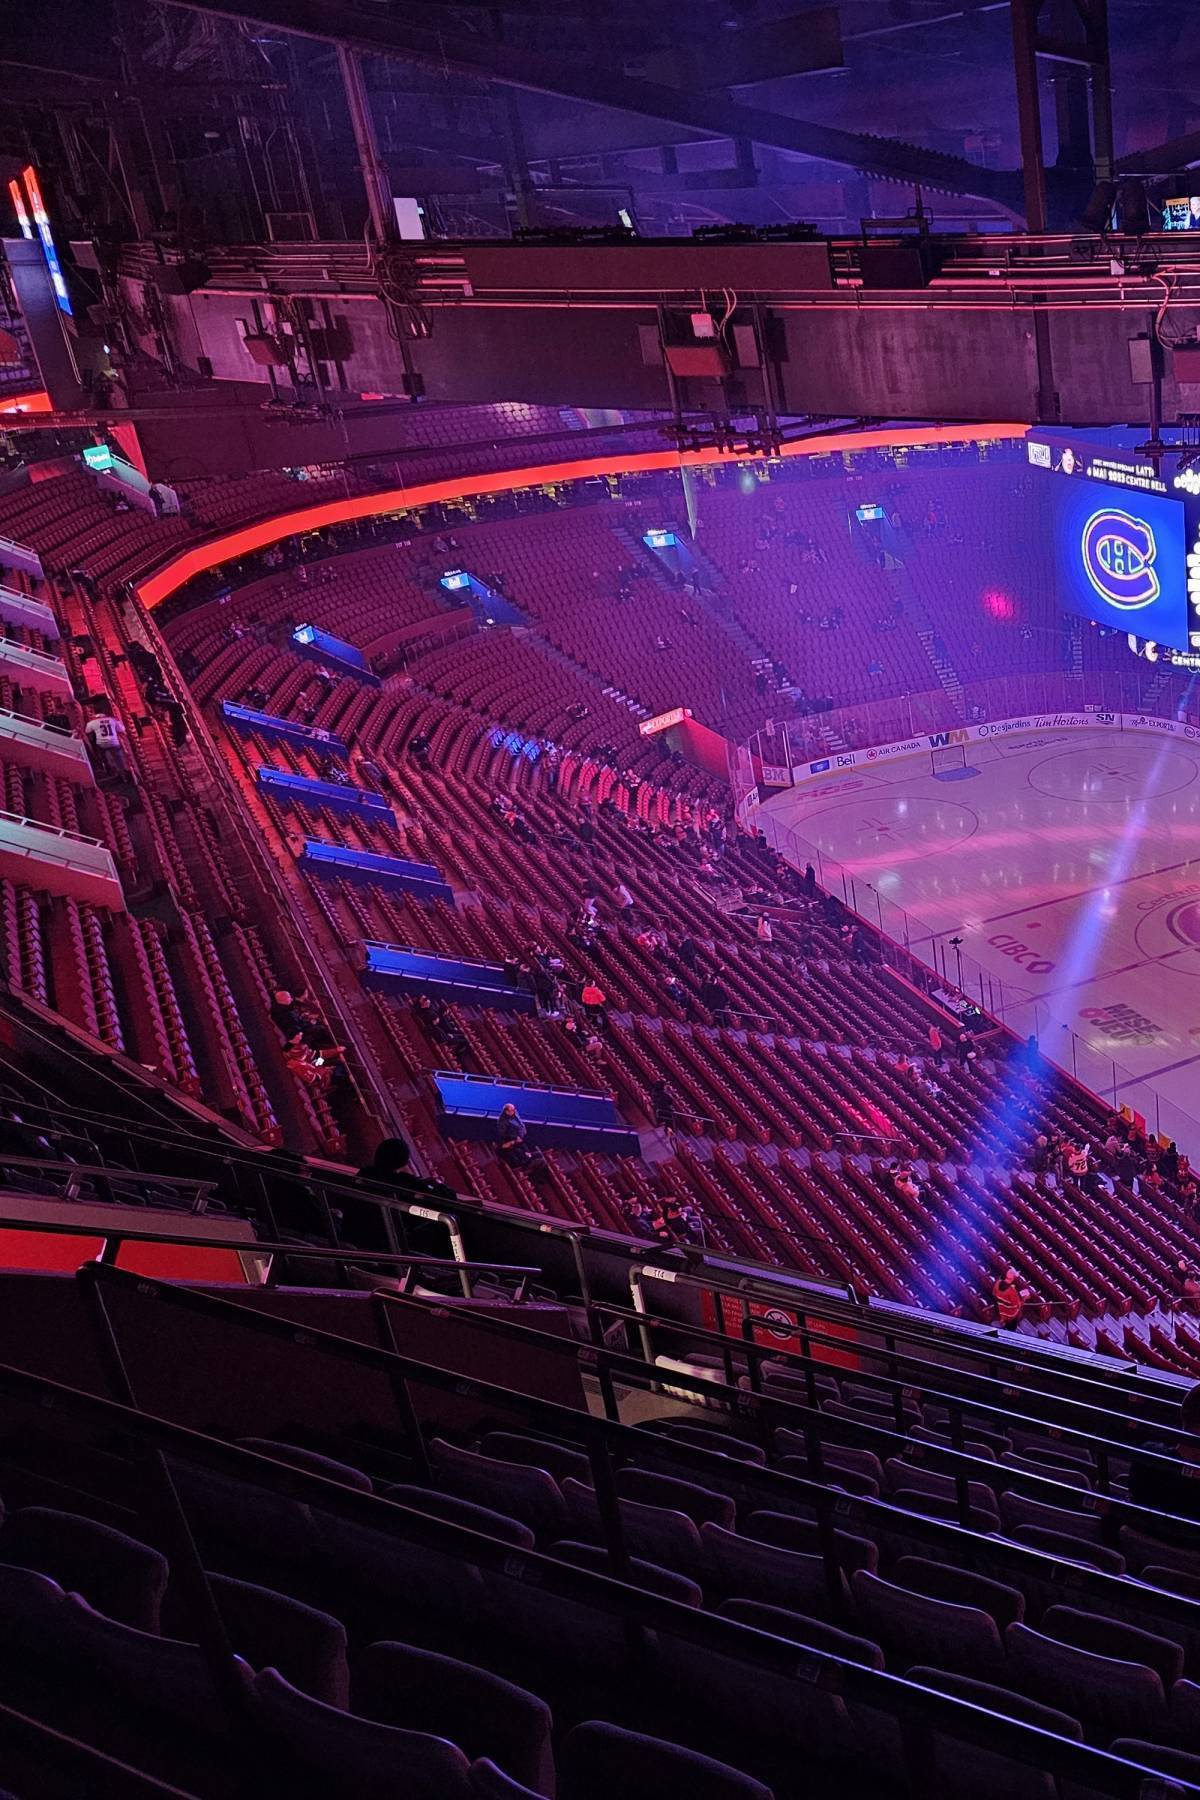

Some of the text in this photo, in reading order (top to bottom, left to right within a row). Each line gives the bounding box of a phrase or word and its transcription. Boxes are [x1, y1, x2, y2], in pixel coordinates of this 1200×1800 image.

[1093, 468, 1107, 480] MAI
[1108, 472, 1126, 484] 2023
[1126, 476, 1150, 489] CENTRE
[1150, 478, 1168, 492] BELL
[1033, 715, 1089, 728] Tim Hortons
[1096, 714, 1115, 722] SN
[100, 724, 114, 737] 31
[928, 729, 970, 748] WM
[878, 742, 921, 756] AIR CANADA
[837, 754, 856, 767] Bell
[988, 935, 1041, 964] CIBC
